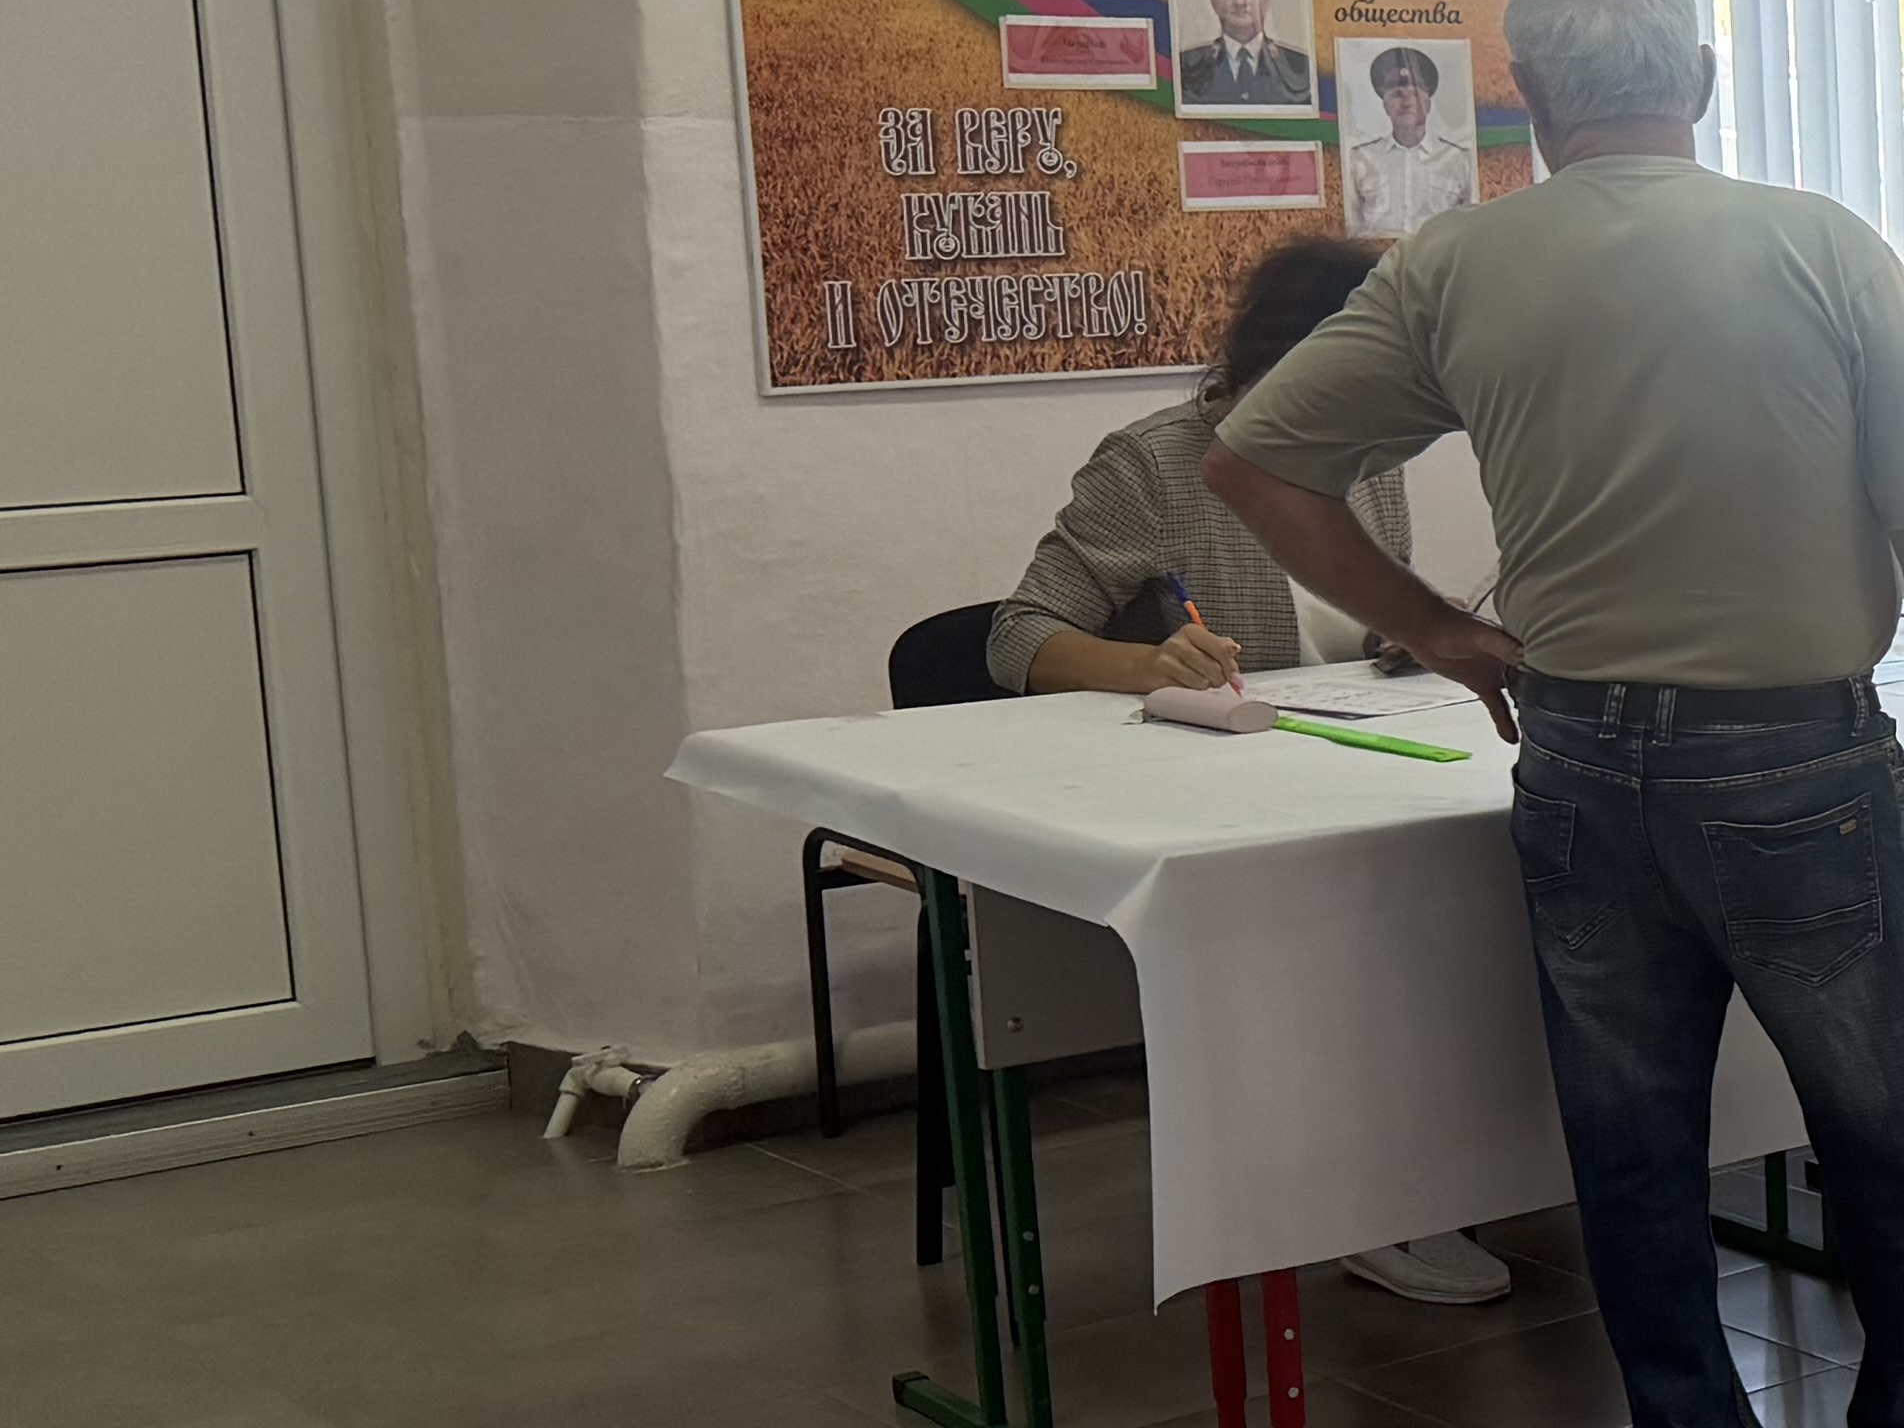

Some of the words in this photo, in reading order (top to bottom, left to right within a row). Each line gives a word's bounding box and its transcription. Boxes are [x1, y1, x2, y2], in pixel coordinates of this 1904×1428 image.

[1334, 0, 1463, 27] общества
[878, 107, 936, 175] ЗА
[954, 107, 1078, 179] ВЕРУ,
[900, 191, 1066, 260] КУБАНЬ
[824, 280, 856, 349] И
[876, 271, 1148, 347] ОТЕЧЕСТВО!
